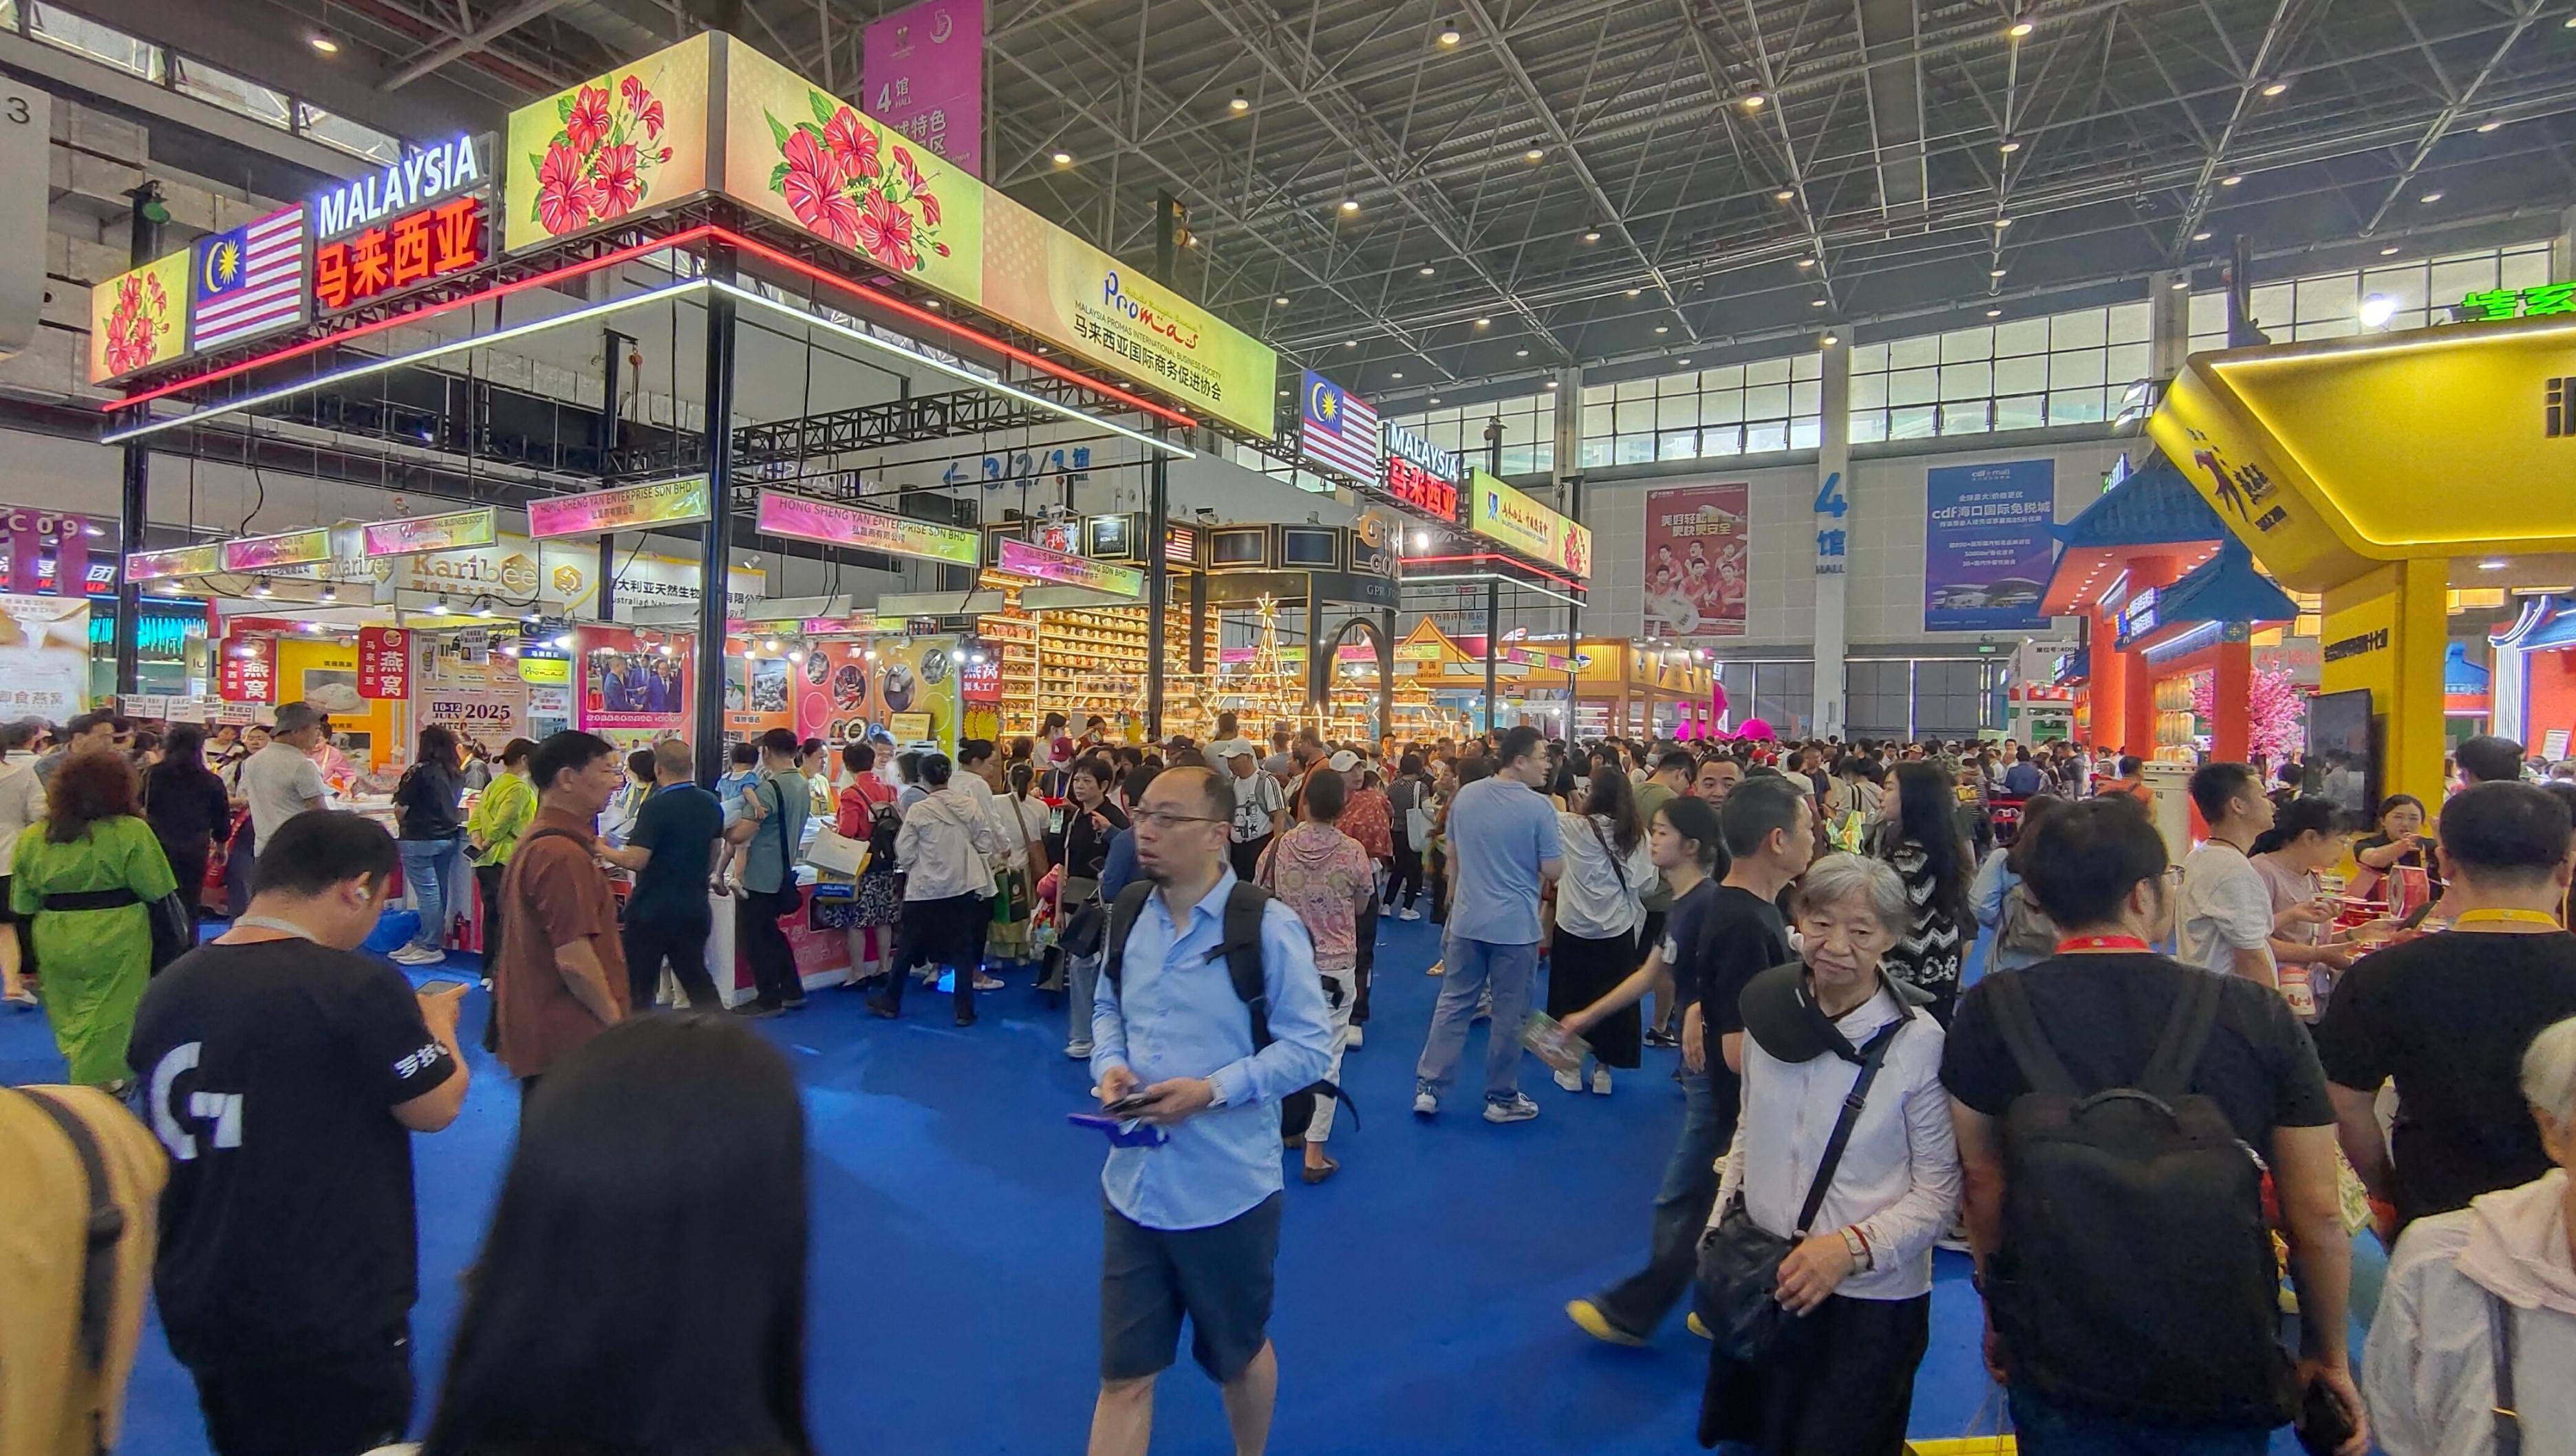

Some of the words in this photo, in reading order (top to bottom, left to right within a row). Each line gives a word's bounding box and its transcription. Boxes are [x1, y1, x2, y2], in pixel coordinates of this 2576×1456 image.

[877, 83, 892, 113] 4
[896, 76, 909, 96] 馆
[7, 96, 30, 125] 3
[895, 97, 912, 109] HALL
[319, 135, 480, 239] MALAYSIA
[316, 197, 478, 308] 马来西亚
[1104, 270, 1199, 350] Promas
[1075, 300, 1106, 323] MALAYSIA
[1107, 317, 1133, 334] PROMAS
[1133, 329, 1176, 357] INTERNATIONAL
[1177, 352, 1201, 370] BUSINESS
[1201, 365, 1221, 379] SOCIETY
[1074, 314, 1222, 401] 马来西亚国际商务促进协会
[1391, 426, 1458, 480] MALAYSIA
[562, 497, 588, 511] SHENG
[589, 495, 604, 507] YAN
[607, 486, 654, 506] ENTERPRISE
[654, 485, 672, 497] SDN
[674, 482, 692, 494] BHD
[1390, 457, 1458, 521] 马来西亚
[1814, 473, 1847, 517] 4
[445, 517, 467, 527] BUSINESS
[780, 499, 811, 513] HONG
[814, 505, 849, 520] SHENG
[851, 512, 870, 524] YAN
[873, 517, 926, 535] ENTERPRISE
[929, 528, 945, 539] SDN
[948, 531, 966, 542] BHD
[1932, 501, 2050, 519] cdf海口国际免税城
[1817, 529, 1846, 556] 馆
[411, 553, 537, 586] Karibee
[1023, 549, 1047, 561] JULIE'S
[1102, 565, 1114, 575] SDN
[1115, 569, 1127, 578] BHD
[1816, 564, 1845, 574] HALL
[1367, 584, 1384, 596] GPR
[244, 661, 269, 699] 燕窝
[365, 641, 376, 685] 马来西亚
[380, 651, 404, 696] 燕窝
[434, 703, 462, 711] 10-12
[465, 704, 511, 719] 2025
